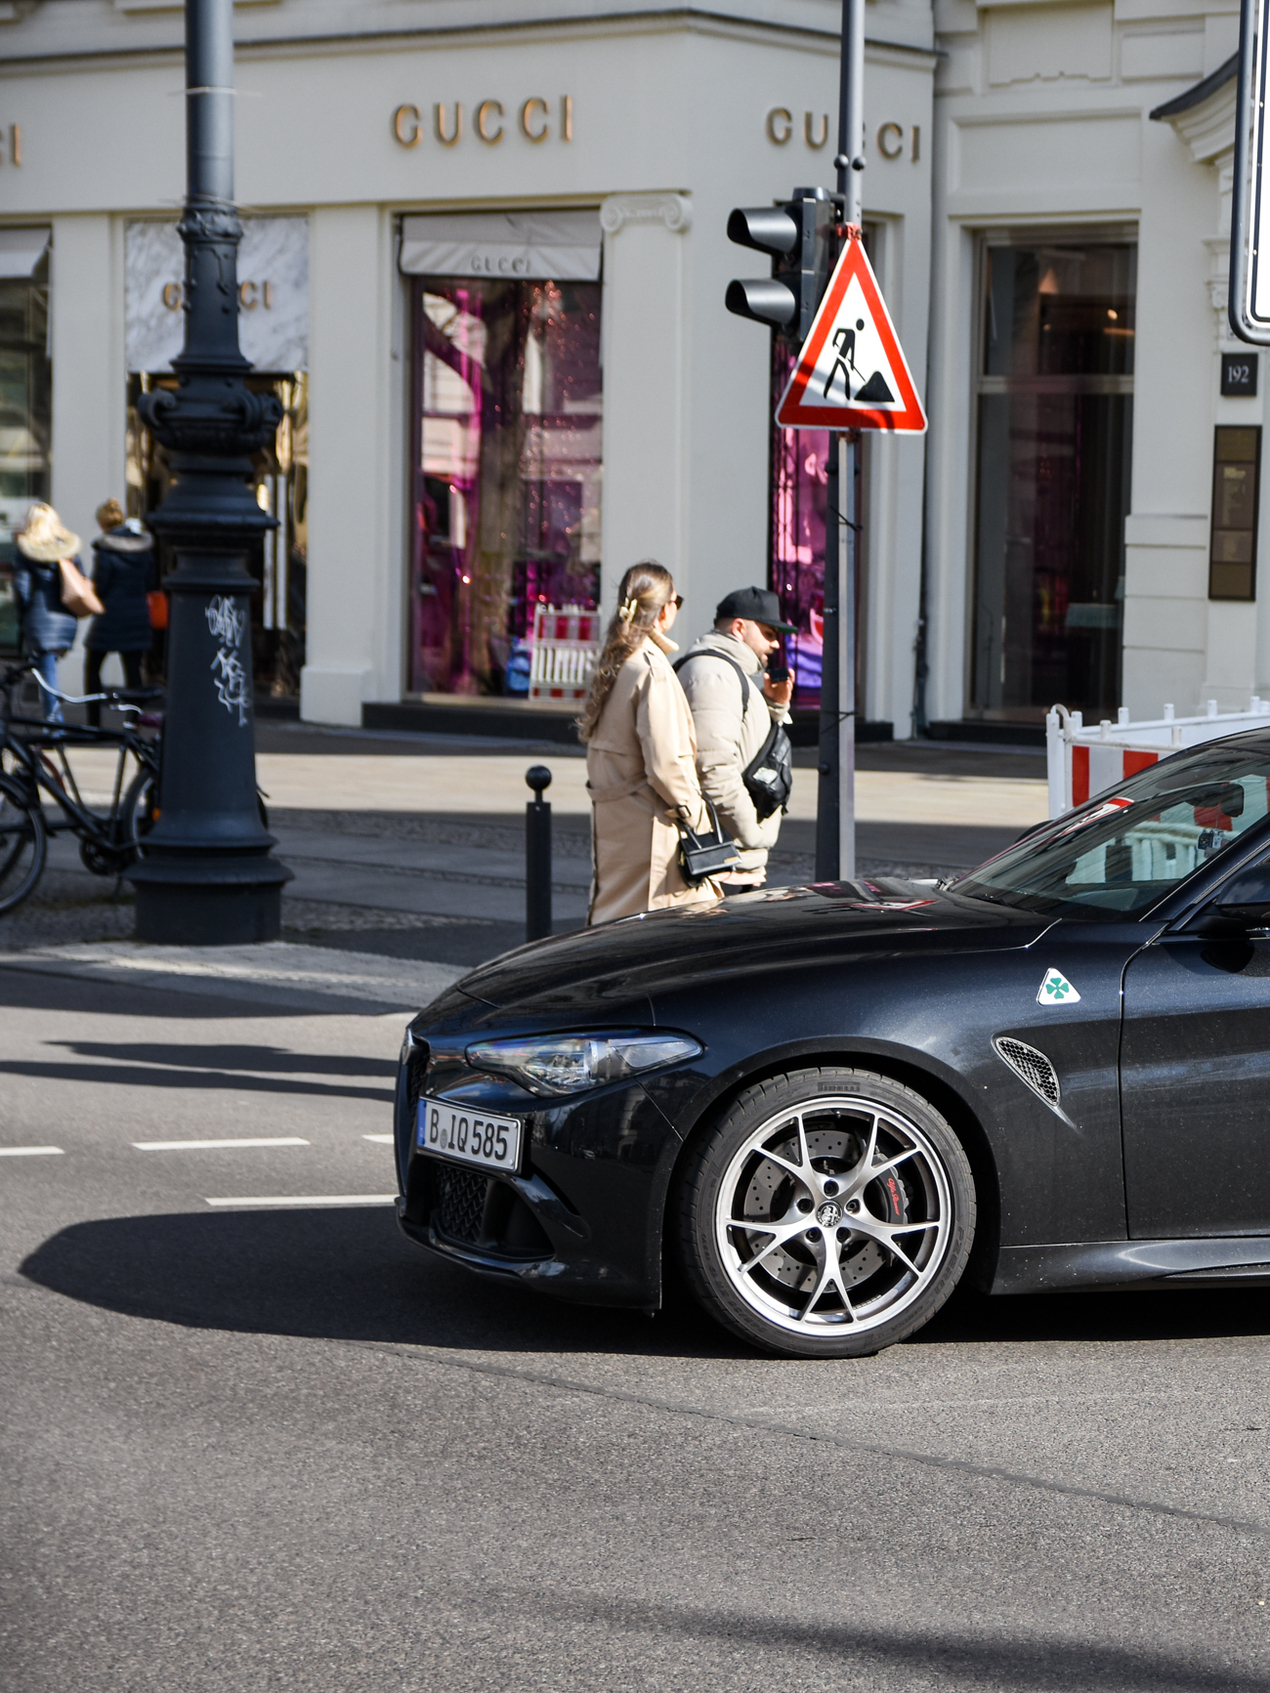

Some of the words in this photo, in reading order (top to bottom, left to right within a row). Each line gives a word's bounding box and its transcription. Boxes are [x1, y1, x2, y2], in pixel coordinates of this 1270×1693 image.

[390, 95, 572, 150] GUCCI
[765, 107, 920, 163] GUCI
[162, 281, 271, 312] GCI
[1227, 366, 1250, 383] 192
